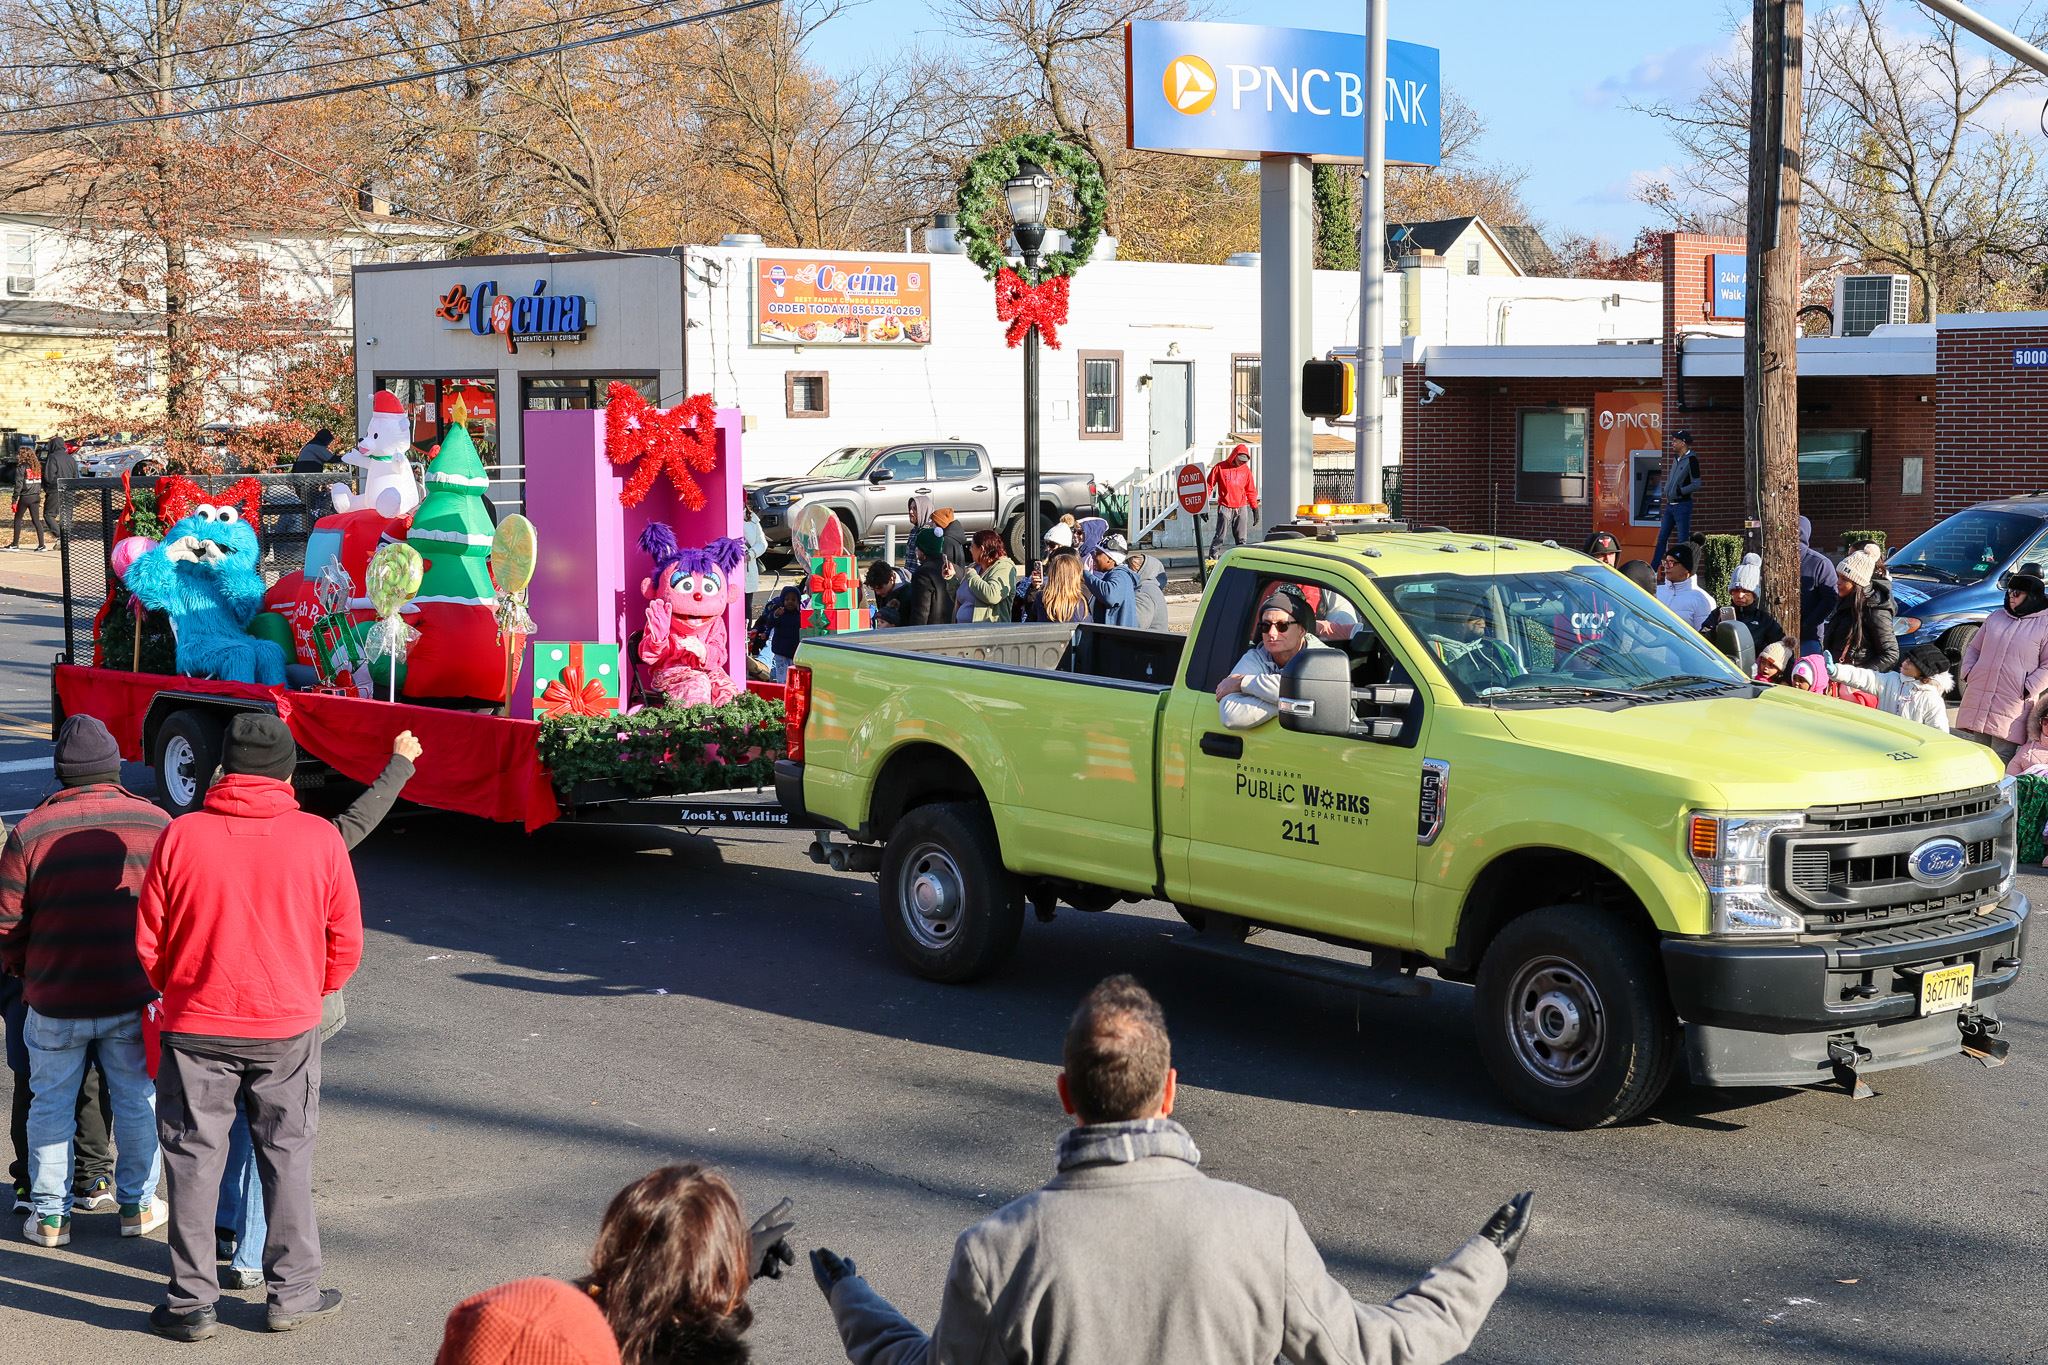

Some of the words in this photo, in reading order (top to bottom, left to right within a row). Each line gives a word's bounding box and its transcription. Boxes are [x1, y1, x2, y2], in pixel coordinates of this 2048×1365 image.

[1334, 71, 1428, 127] BNK
[1720, 272, 1740, 283] 24hr
[815, 296, 838, 304] FAMILY
[435, 283, 471, 322] La
[469, 279, 588, 348] Cocína
[769, 303, 806, 313] ORDER
[809, 304, 849, 314] TODAY!
[852, 305, 921, 316] 856.324.0269
[1181, 475, 1189, 484] DO
[1190, 472, 1200, 482] NOT
[1185, 495, 1202, 506] ENTER
[1886, 751, 1919, 762] 211
[1236, 763, 1302, 779] Pennsauken
[1236, 772, 1295, 804] PUBLIC
[1302, 783, 1370, 815] WORKS
[681, 809, 727, 821] Zook's
[731, 810, 789, 825] Welding
[1303, 808, 1369, 827] DEPARTMENT
[1281, 818, 1320, 846] 211
[1927, 850, 1955, 872] Ford
[1925, 975, 1970, 1004] 36277MG
